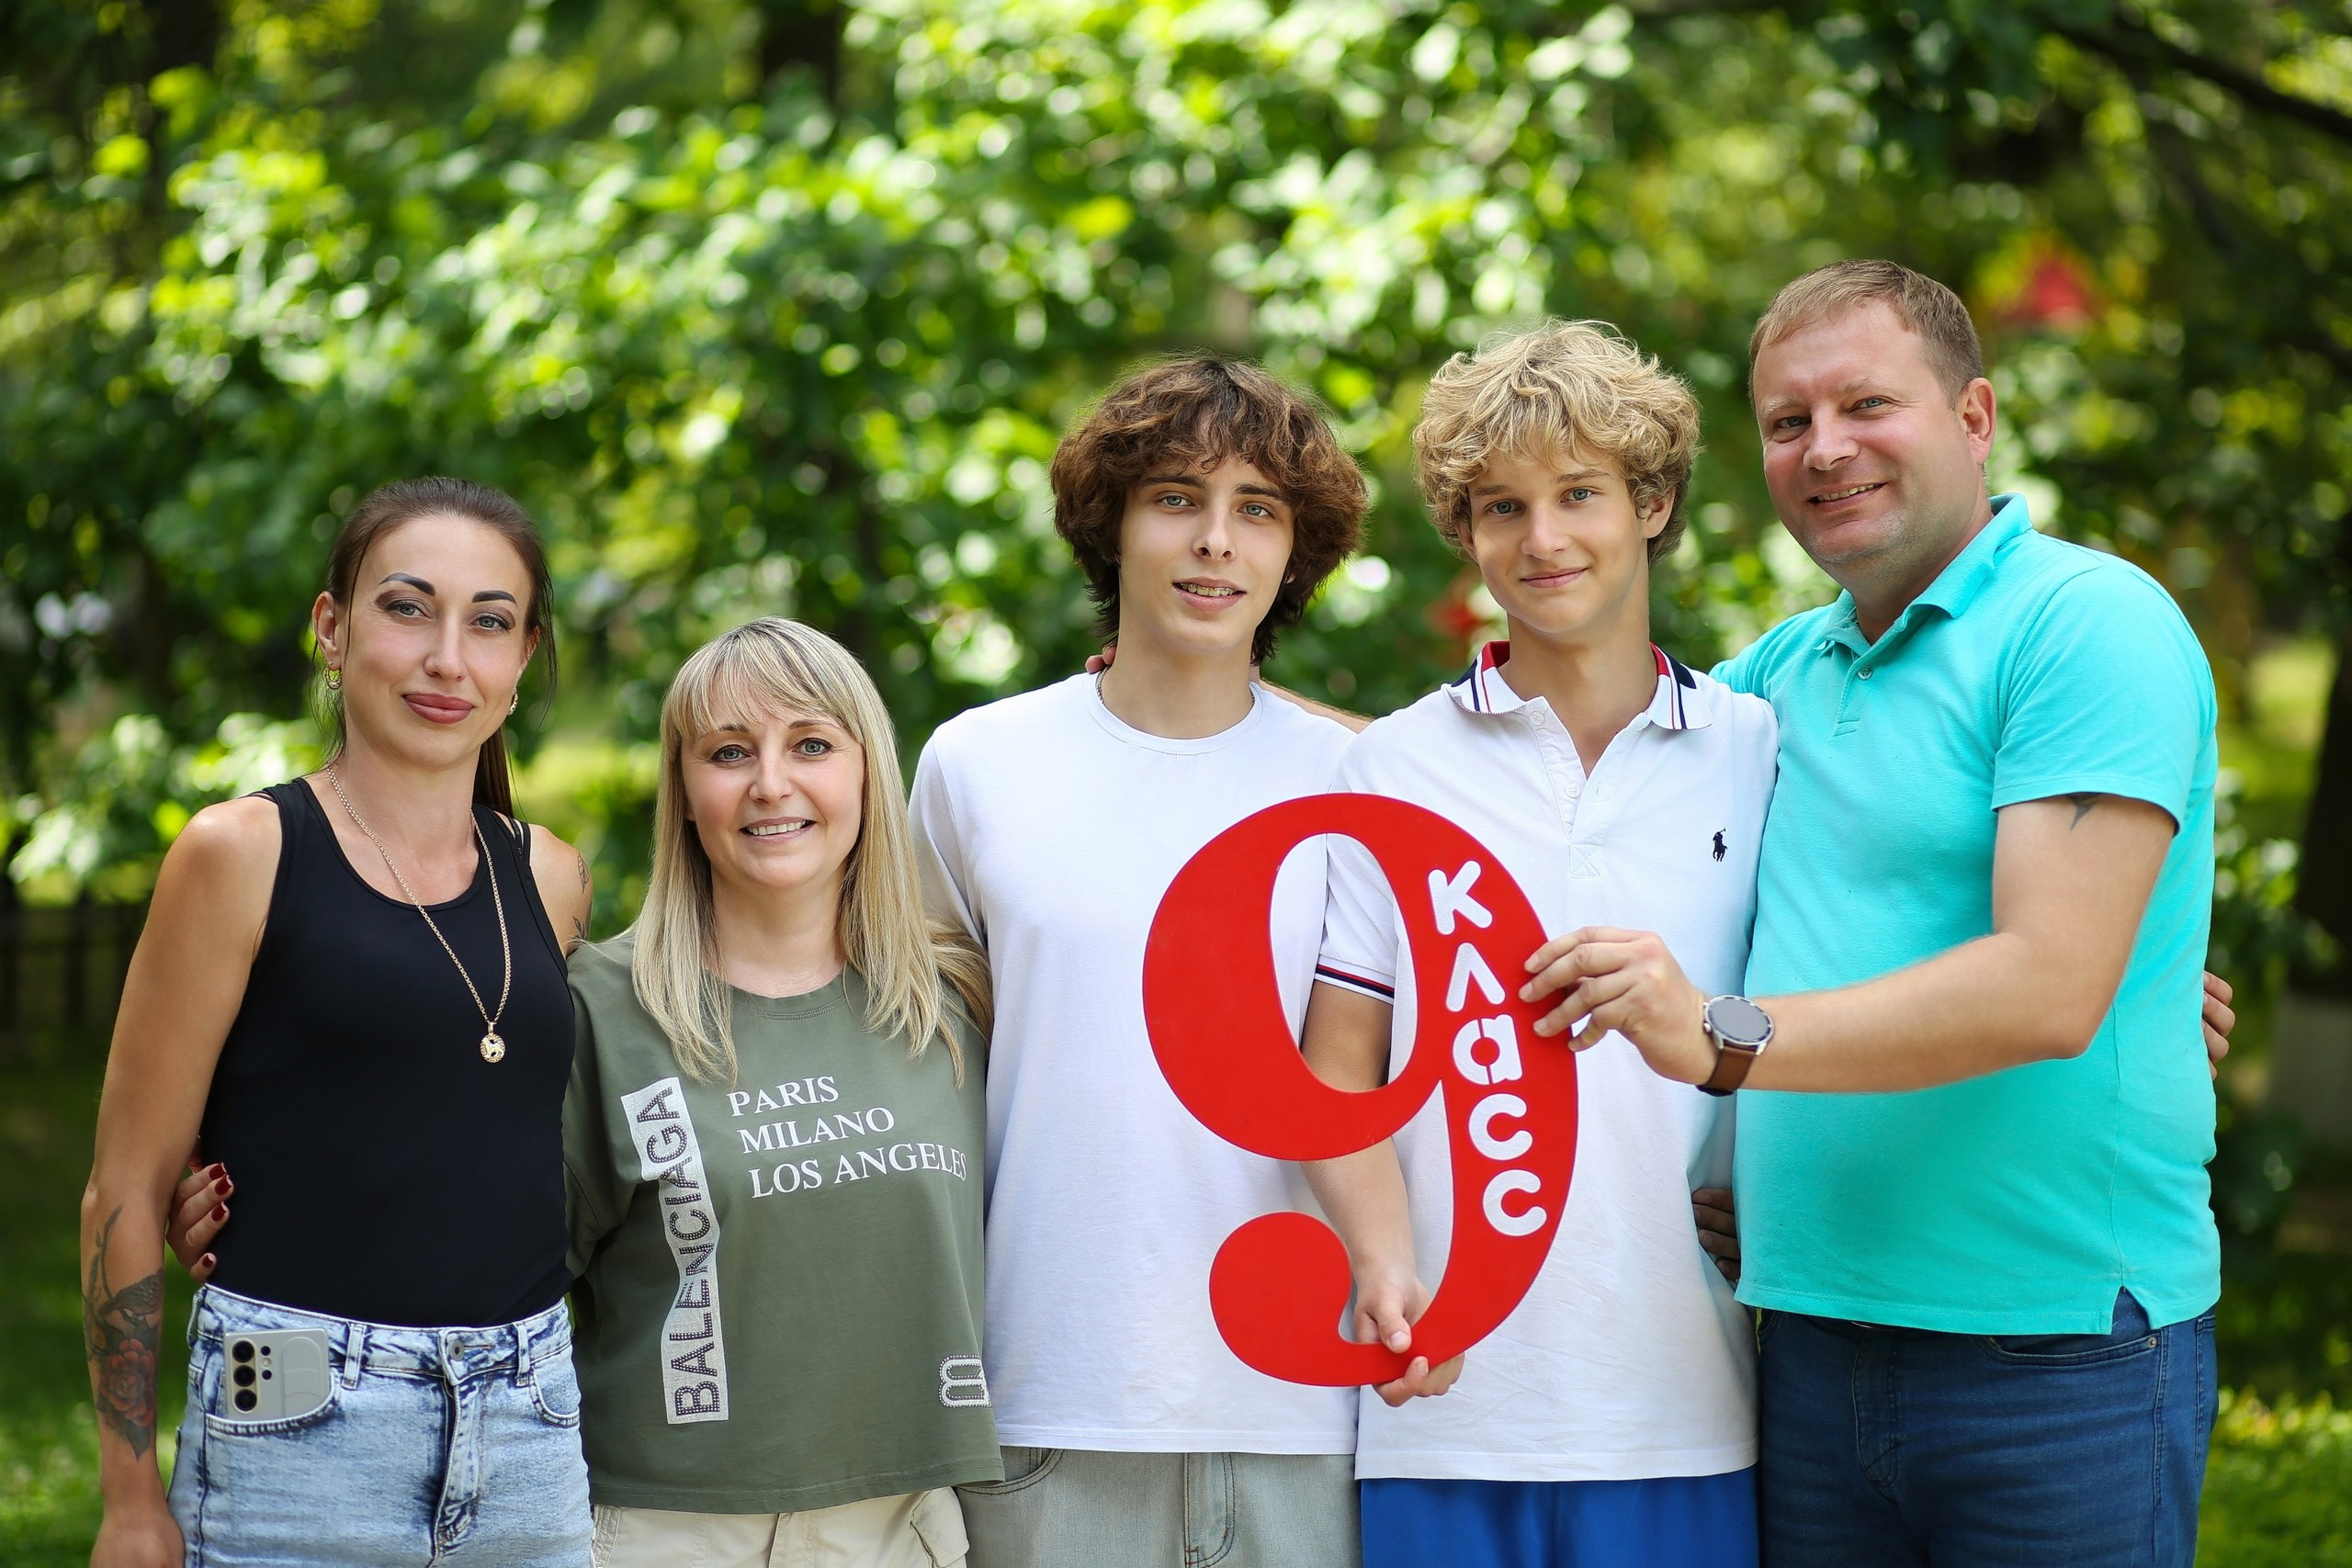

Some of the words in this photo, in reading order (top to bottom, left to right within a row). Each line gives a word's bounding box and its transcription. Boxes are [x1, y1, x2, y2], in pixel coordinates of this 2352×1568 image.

[726, 1076, 840, 1117] PARIS
[1142, 792, 1579, 1387] 9
[736, 1107, 895, 1155] MILANO
[748, 1158, 823, 1199] LOS
[833, 1143, 967, 1184] ANGELES
[637, 1086, 720, 1416] BALENCIAGA
